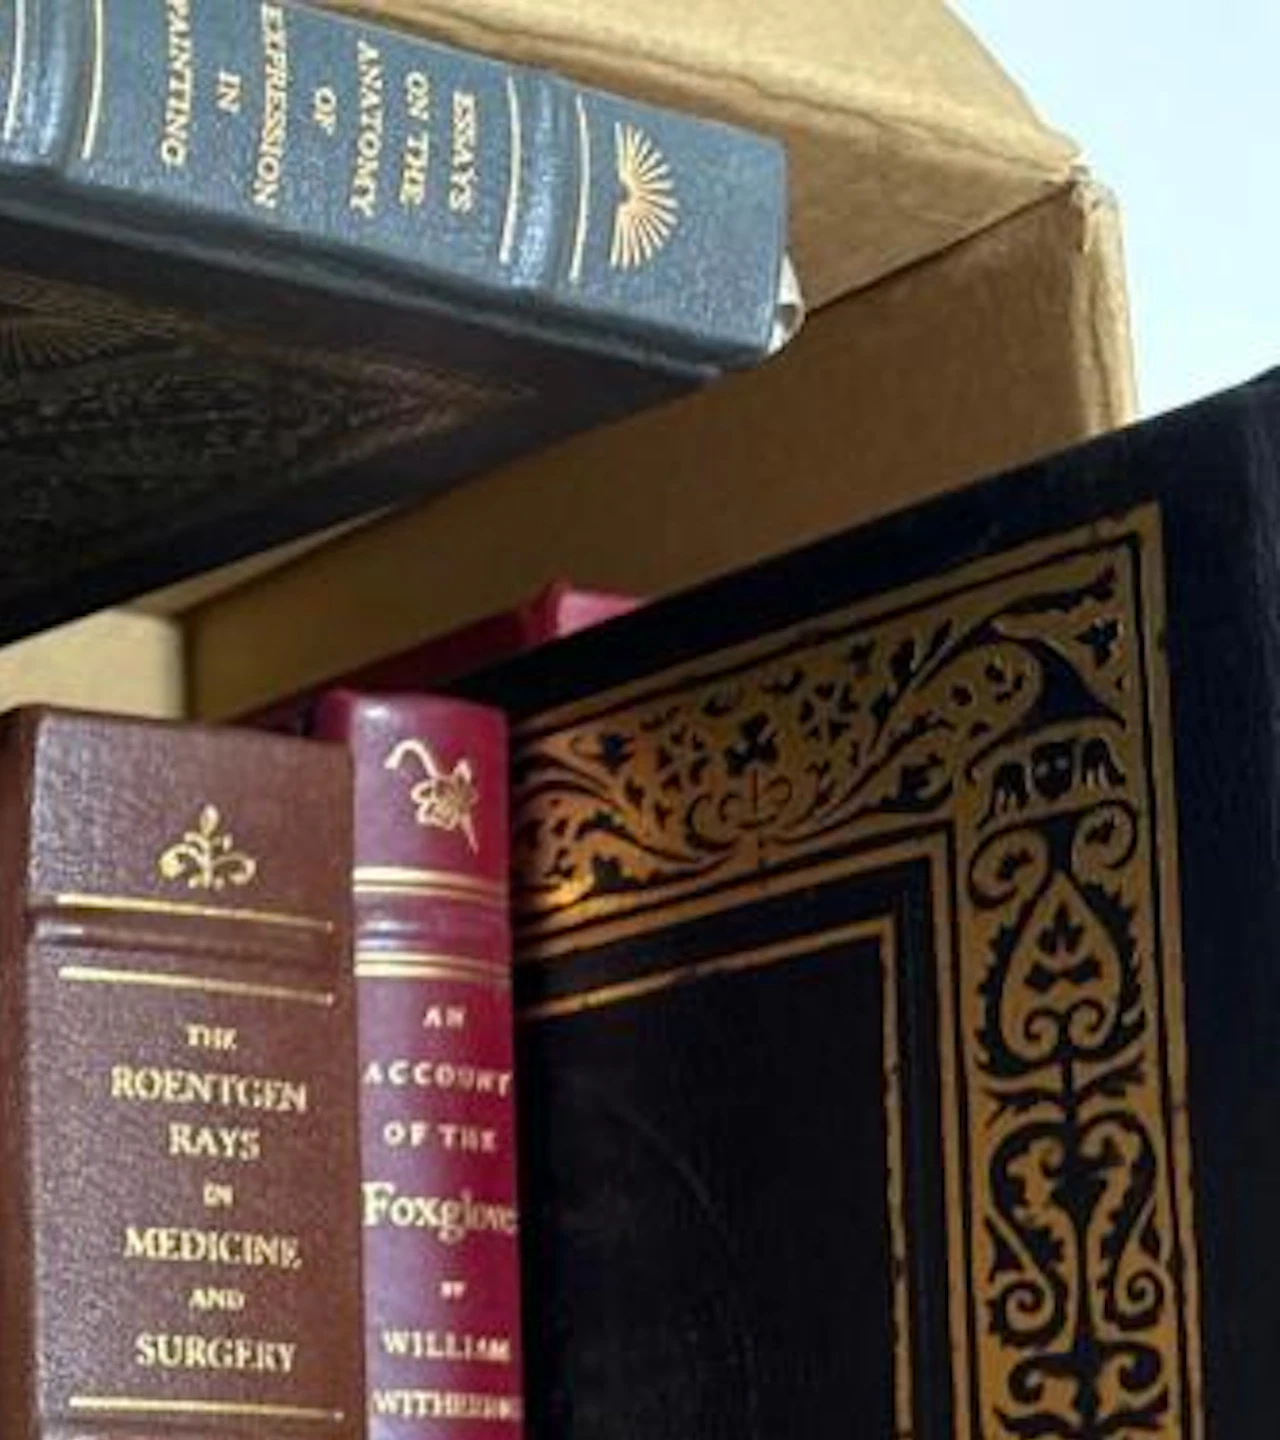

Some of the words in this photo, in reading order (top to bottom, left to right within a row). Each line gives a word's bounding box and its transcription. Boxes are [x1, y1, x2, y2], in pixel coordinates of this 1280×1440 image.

[218, 69, 241, 113] IN
[254, 3, 288, 208] EXPRESSION
[314, 87, 337, 136] OF
[404, 71, 429, 121] ON
[351, 40, 384, 218] ANATOMY
[401, 131, 429, 206] THE
[449, 90, 478, 214] ESSAYS
[186, 1024, 238, 1050] THE
[423, 1006, 468, 1030] AN
[110, 1064, 308, 1112] ROENTGEN
[364, 1060, 511, 1097] ACCOUNT
[168, 1122, 260, 1161] RAYS
[383, 1120, 430, 1147] OF
[124, 1225, 303, 1269] MEDICINE
[190, 1287, 245, 1311] AND
[136, 1332, 297, 1373] SURGERY
[383, 1330, 511, 1363] WILLIAM
